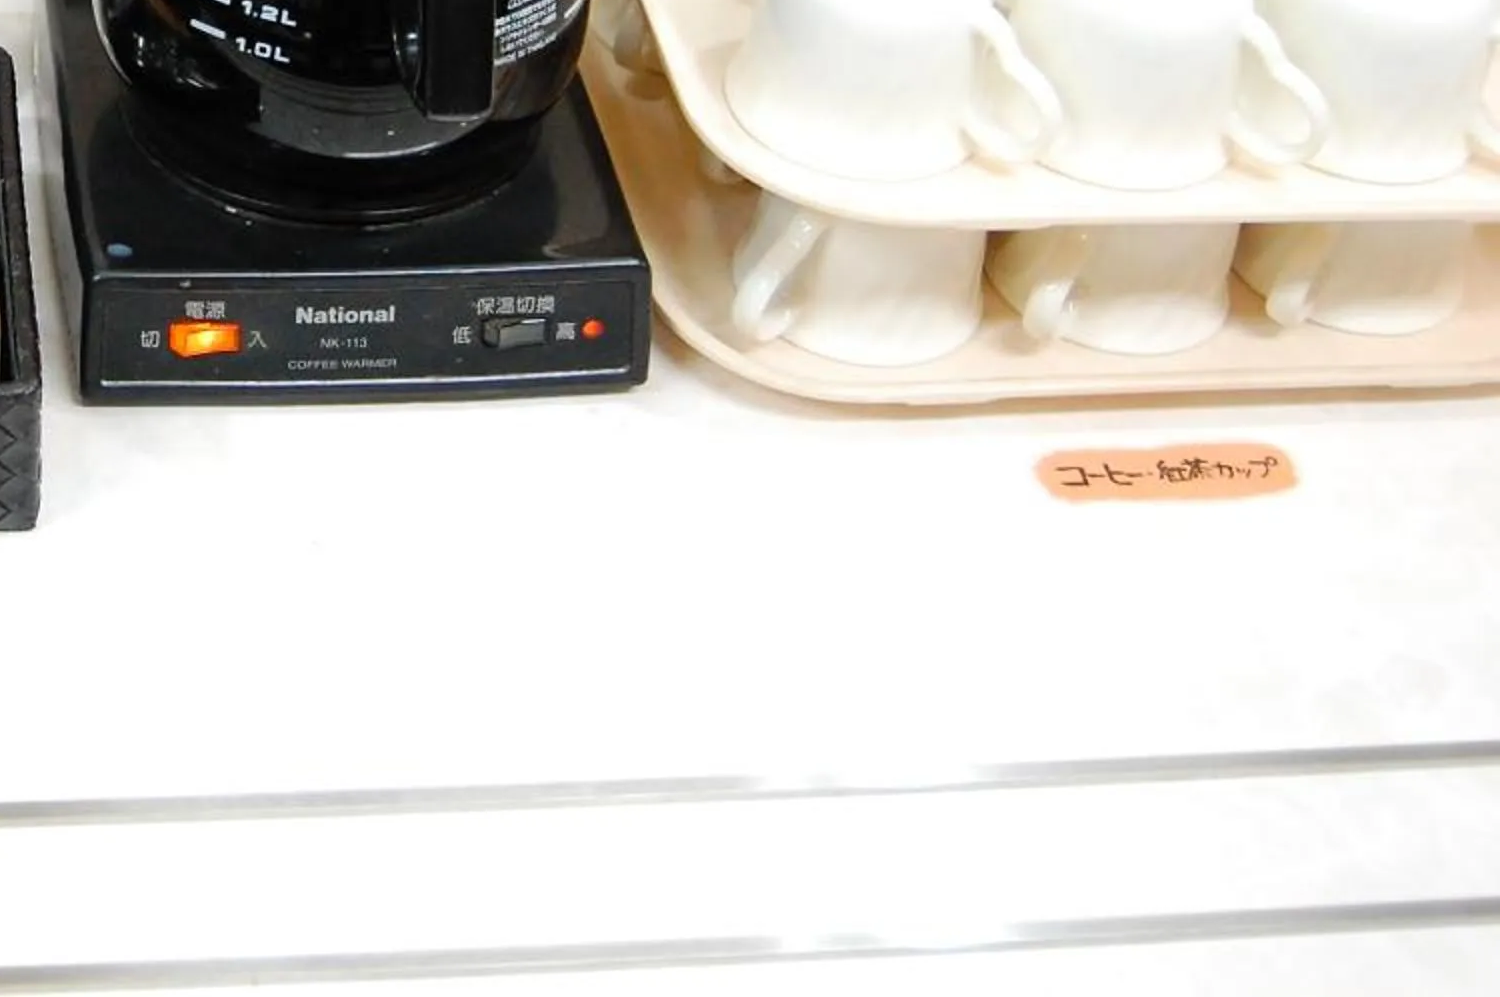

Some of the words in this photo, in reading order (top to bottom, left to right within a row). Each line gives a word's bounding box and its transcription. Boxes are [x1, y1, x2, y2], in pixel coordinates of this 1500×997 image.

[241, 0, 297, 28] 1.2L
[235, 36, 290, 64] 1.0L
[184, 300, 227, 319] 電源
[295, 305, 396, 324] National
[140, 329, 161, 348] 切
[247, 329, 268, 348] 入
[451, 324, 473, 344] 低
[555, 321, 577, 341] 高
[287, 358, 338, 371] COFFEE
[341, 357, 398, 370] WARMER
